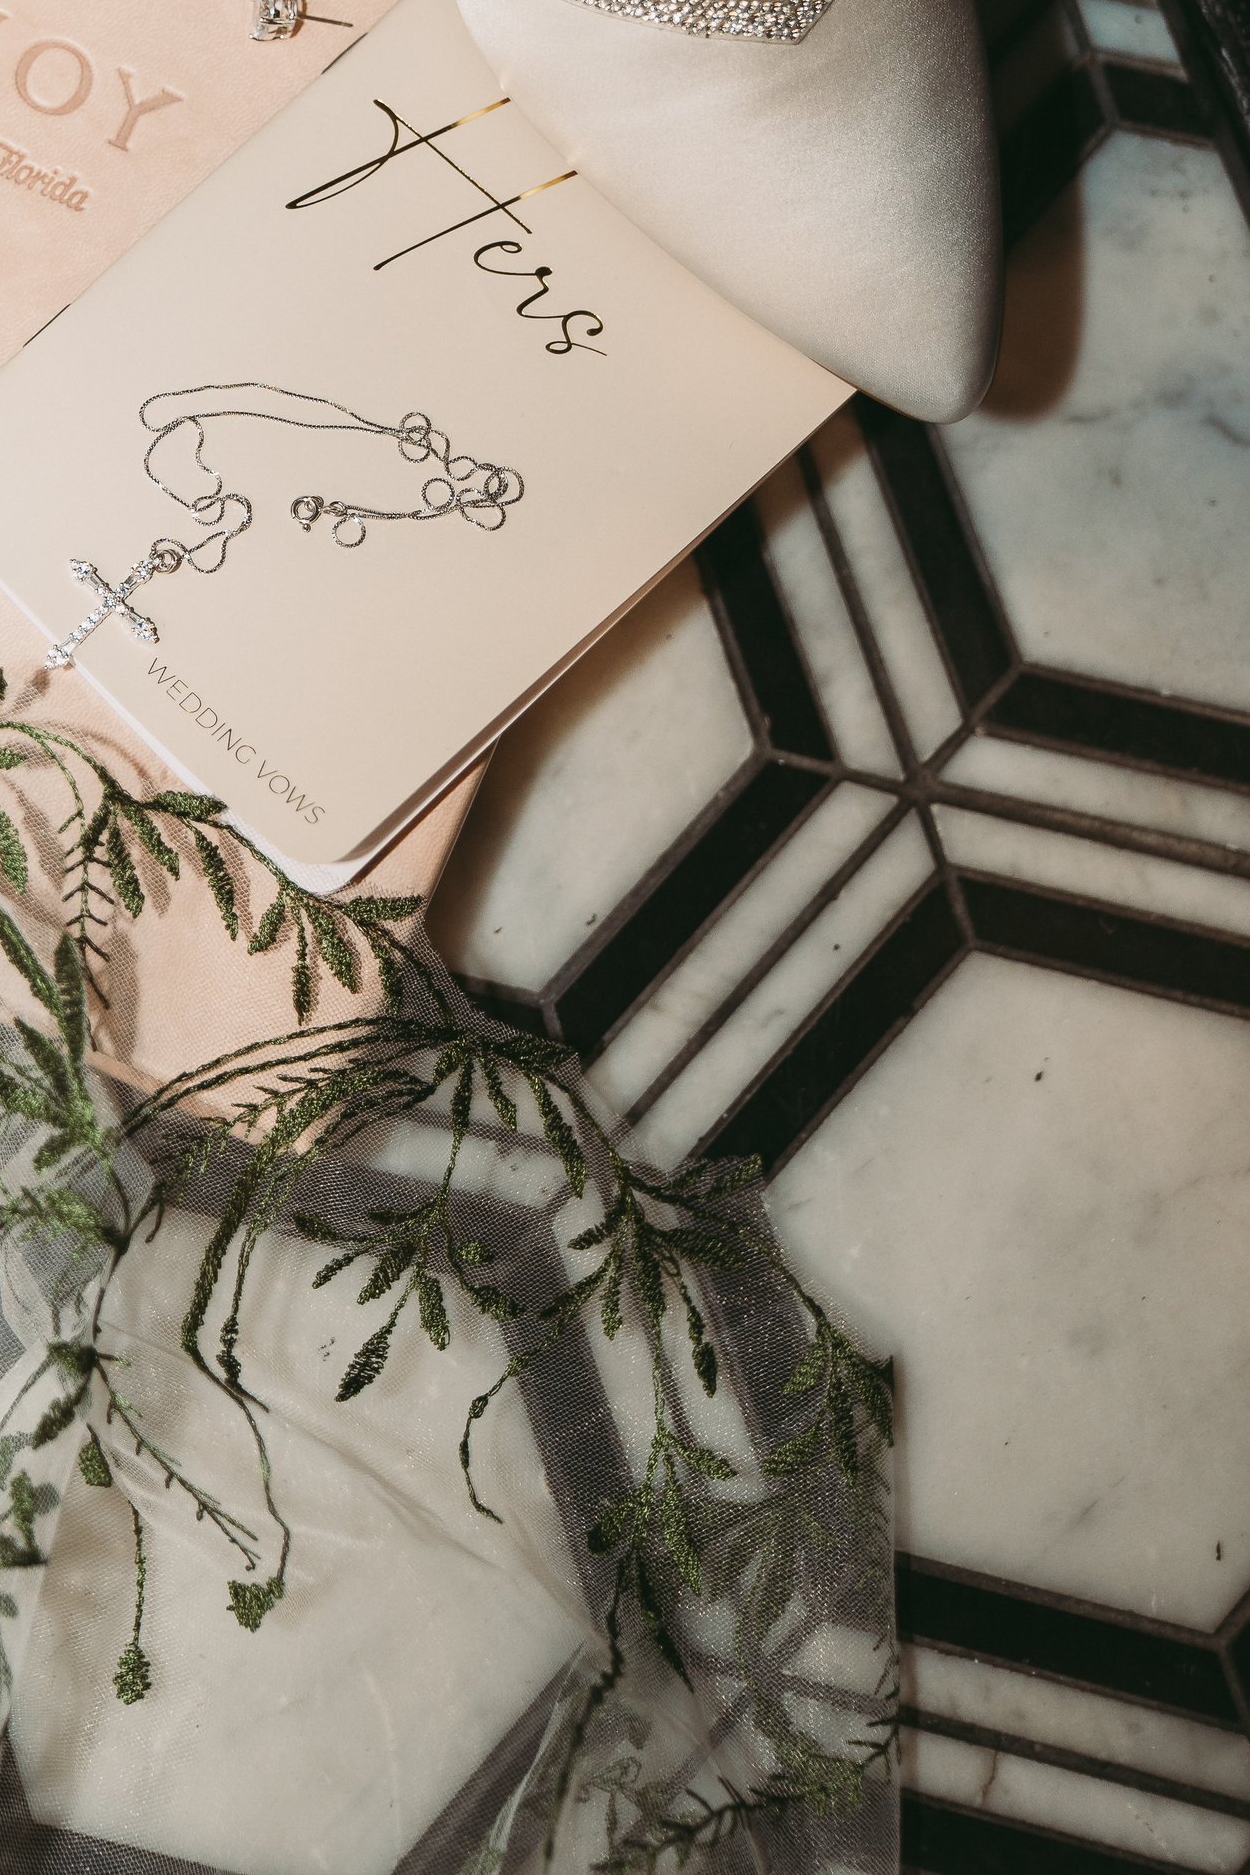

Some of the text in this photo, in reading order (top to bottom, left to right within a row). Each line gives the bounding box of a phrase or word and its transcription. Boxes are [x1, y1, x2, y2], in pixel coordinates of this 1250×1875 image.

[284, 96, 608, 356] Hers
[147, 657, 326, 825] WEDDING VOWS
